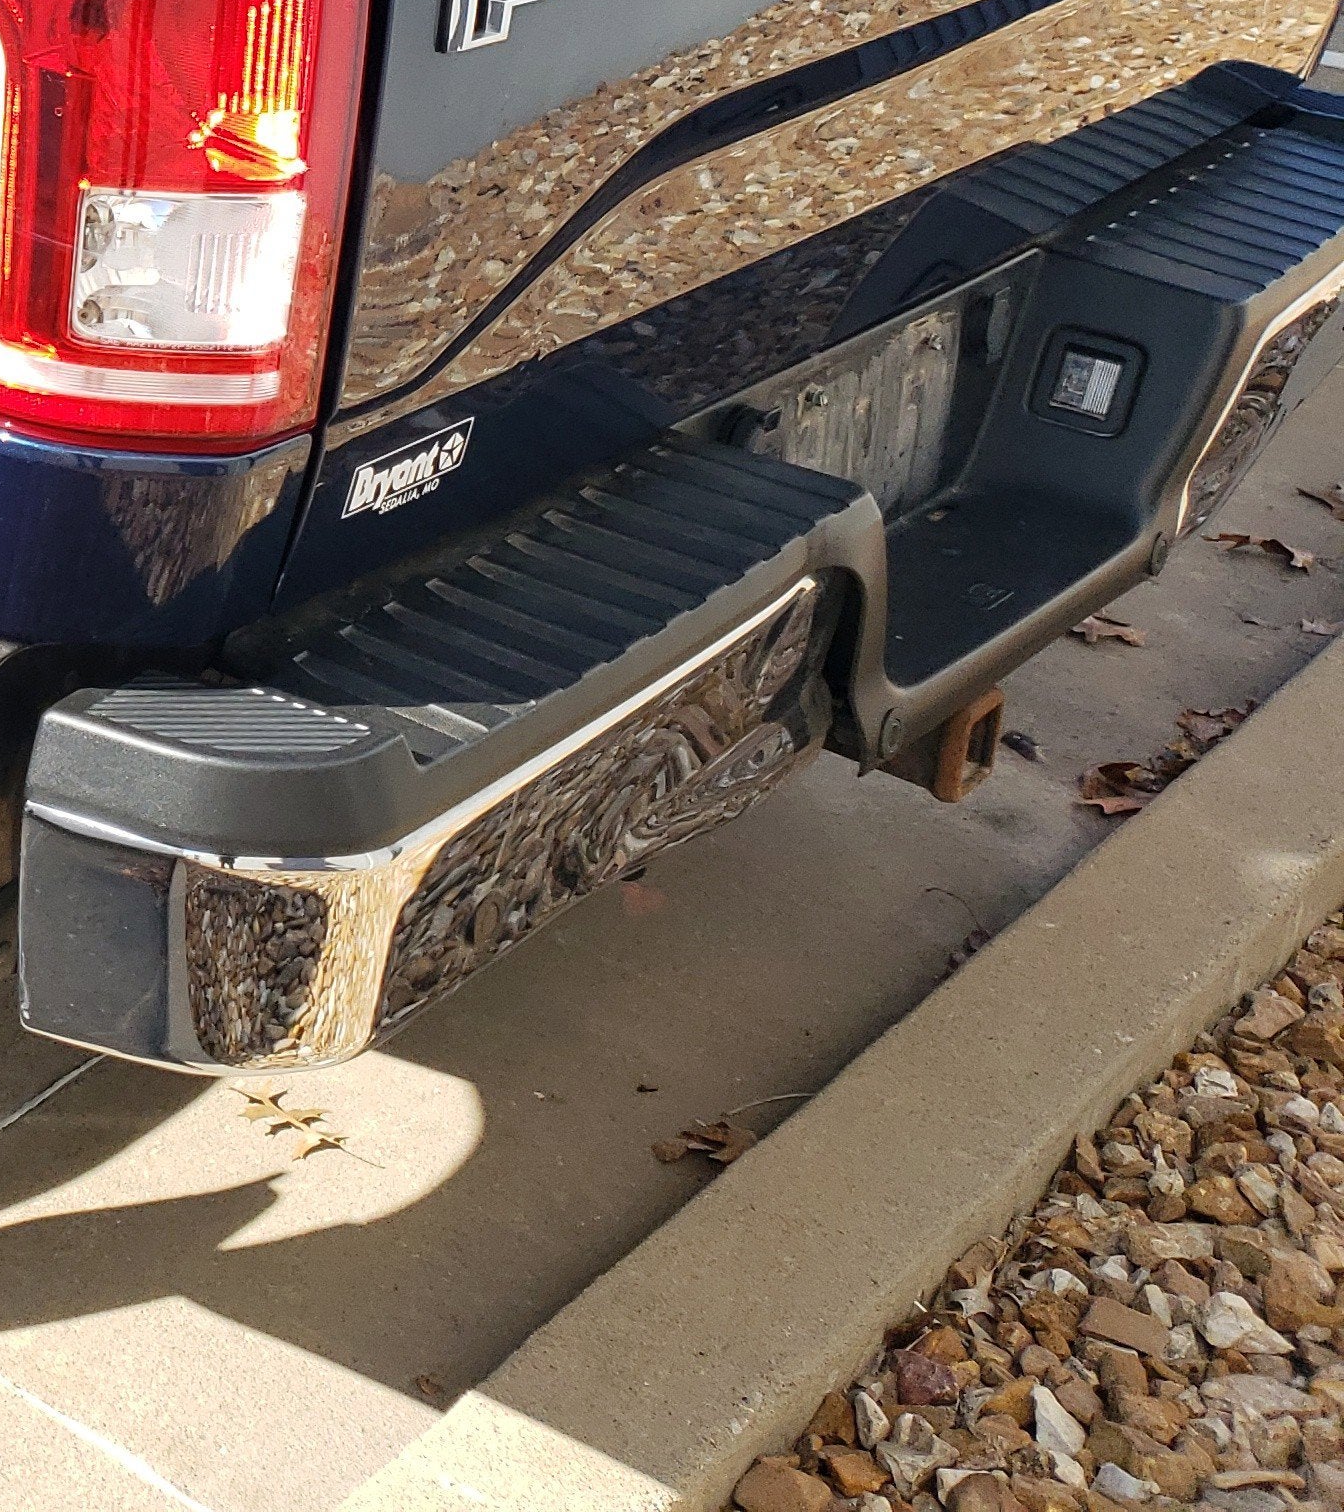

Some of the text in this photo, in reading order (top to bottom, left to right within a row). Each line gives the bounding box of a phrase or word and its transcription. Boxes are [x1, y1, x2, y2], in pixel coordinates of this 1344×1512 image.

[348, 440, 440, 511] Bryant
[378, 478, 440, 515] SEDALIA, MO
